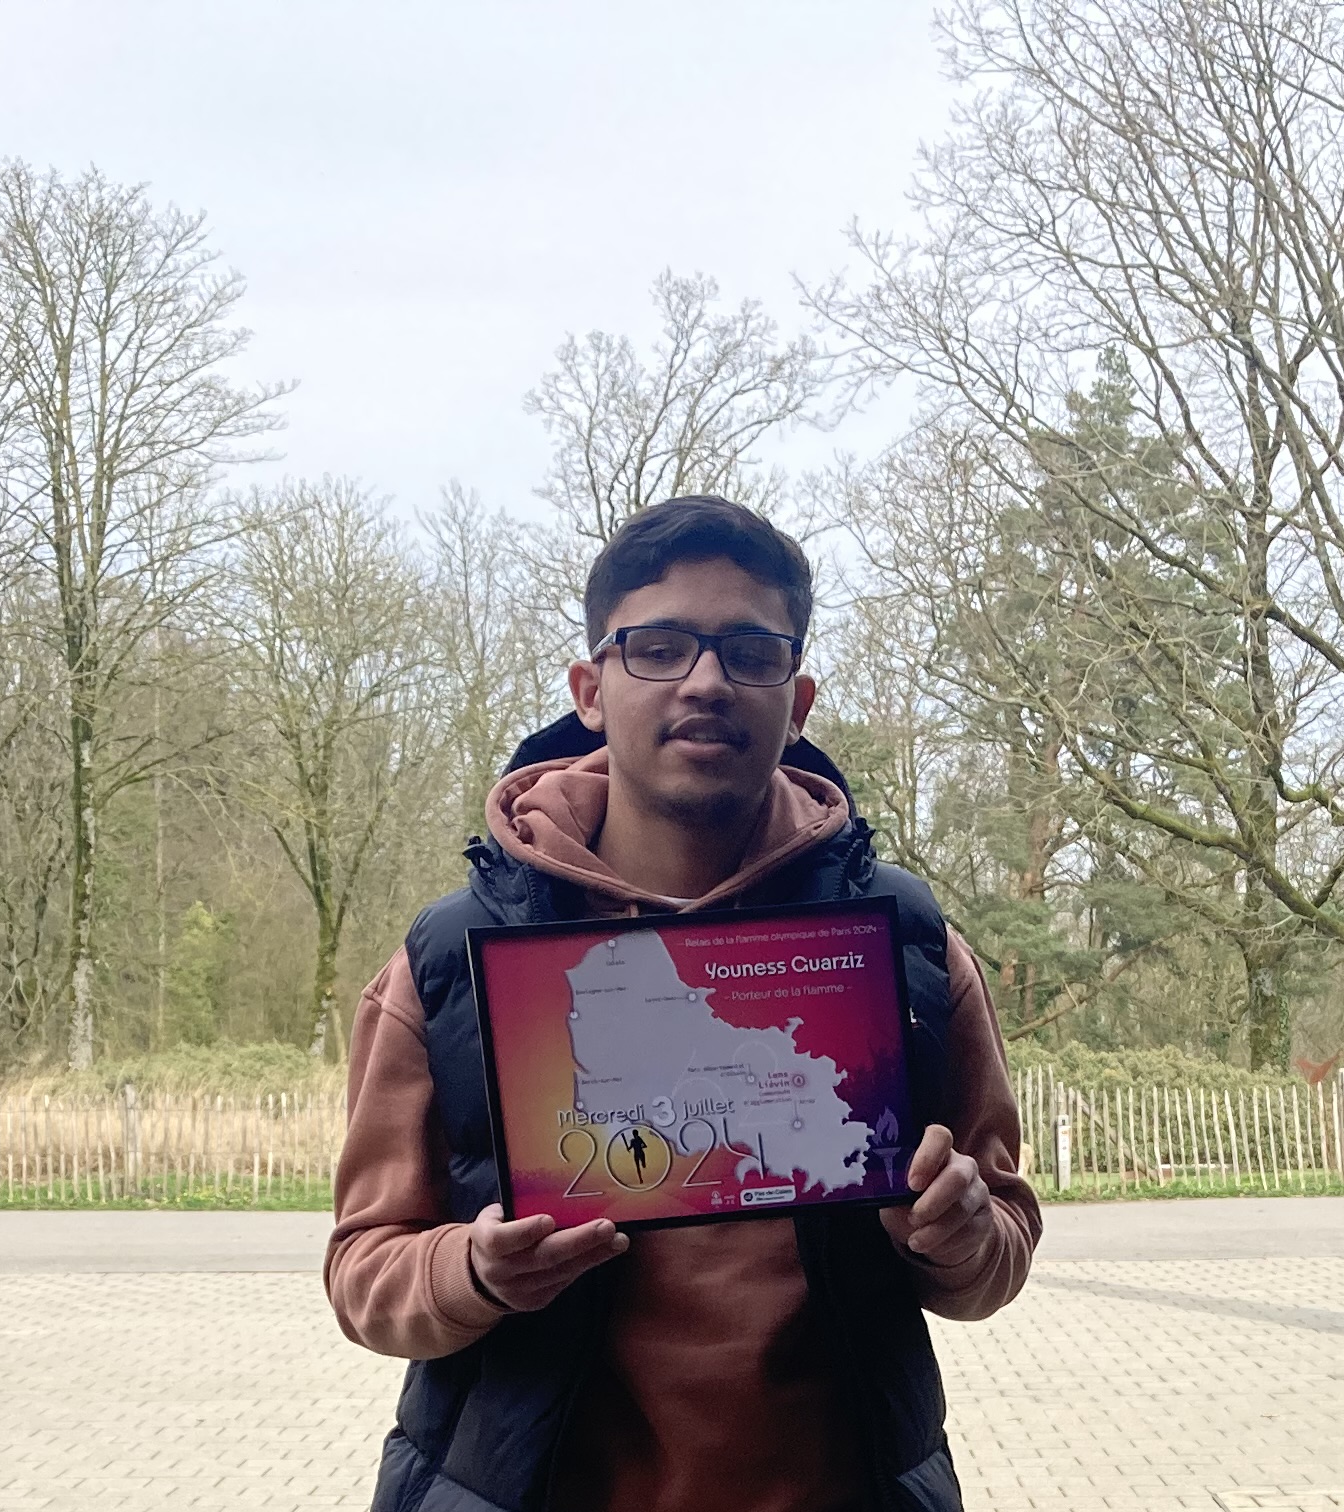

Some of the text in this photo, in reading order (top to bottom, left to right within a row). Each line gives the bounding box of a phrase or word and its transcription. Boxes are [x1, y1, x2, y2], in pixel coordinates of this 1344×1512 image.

[684, 924, 877, 947] Relais de la flamme olympique de Paris 2024
[705, 951, 865, 980] Youness Guarziz
[731, 983, 845, 1001] Porteur de la flamme
[557, 1095, 736, 1128] Mercredi 3 juillet
[558, 1117, 765, 1199] 2024
